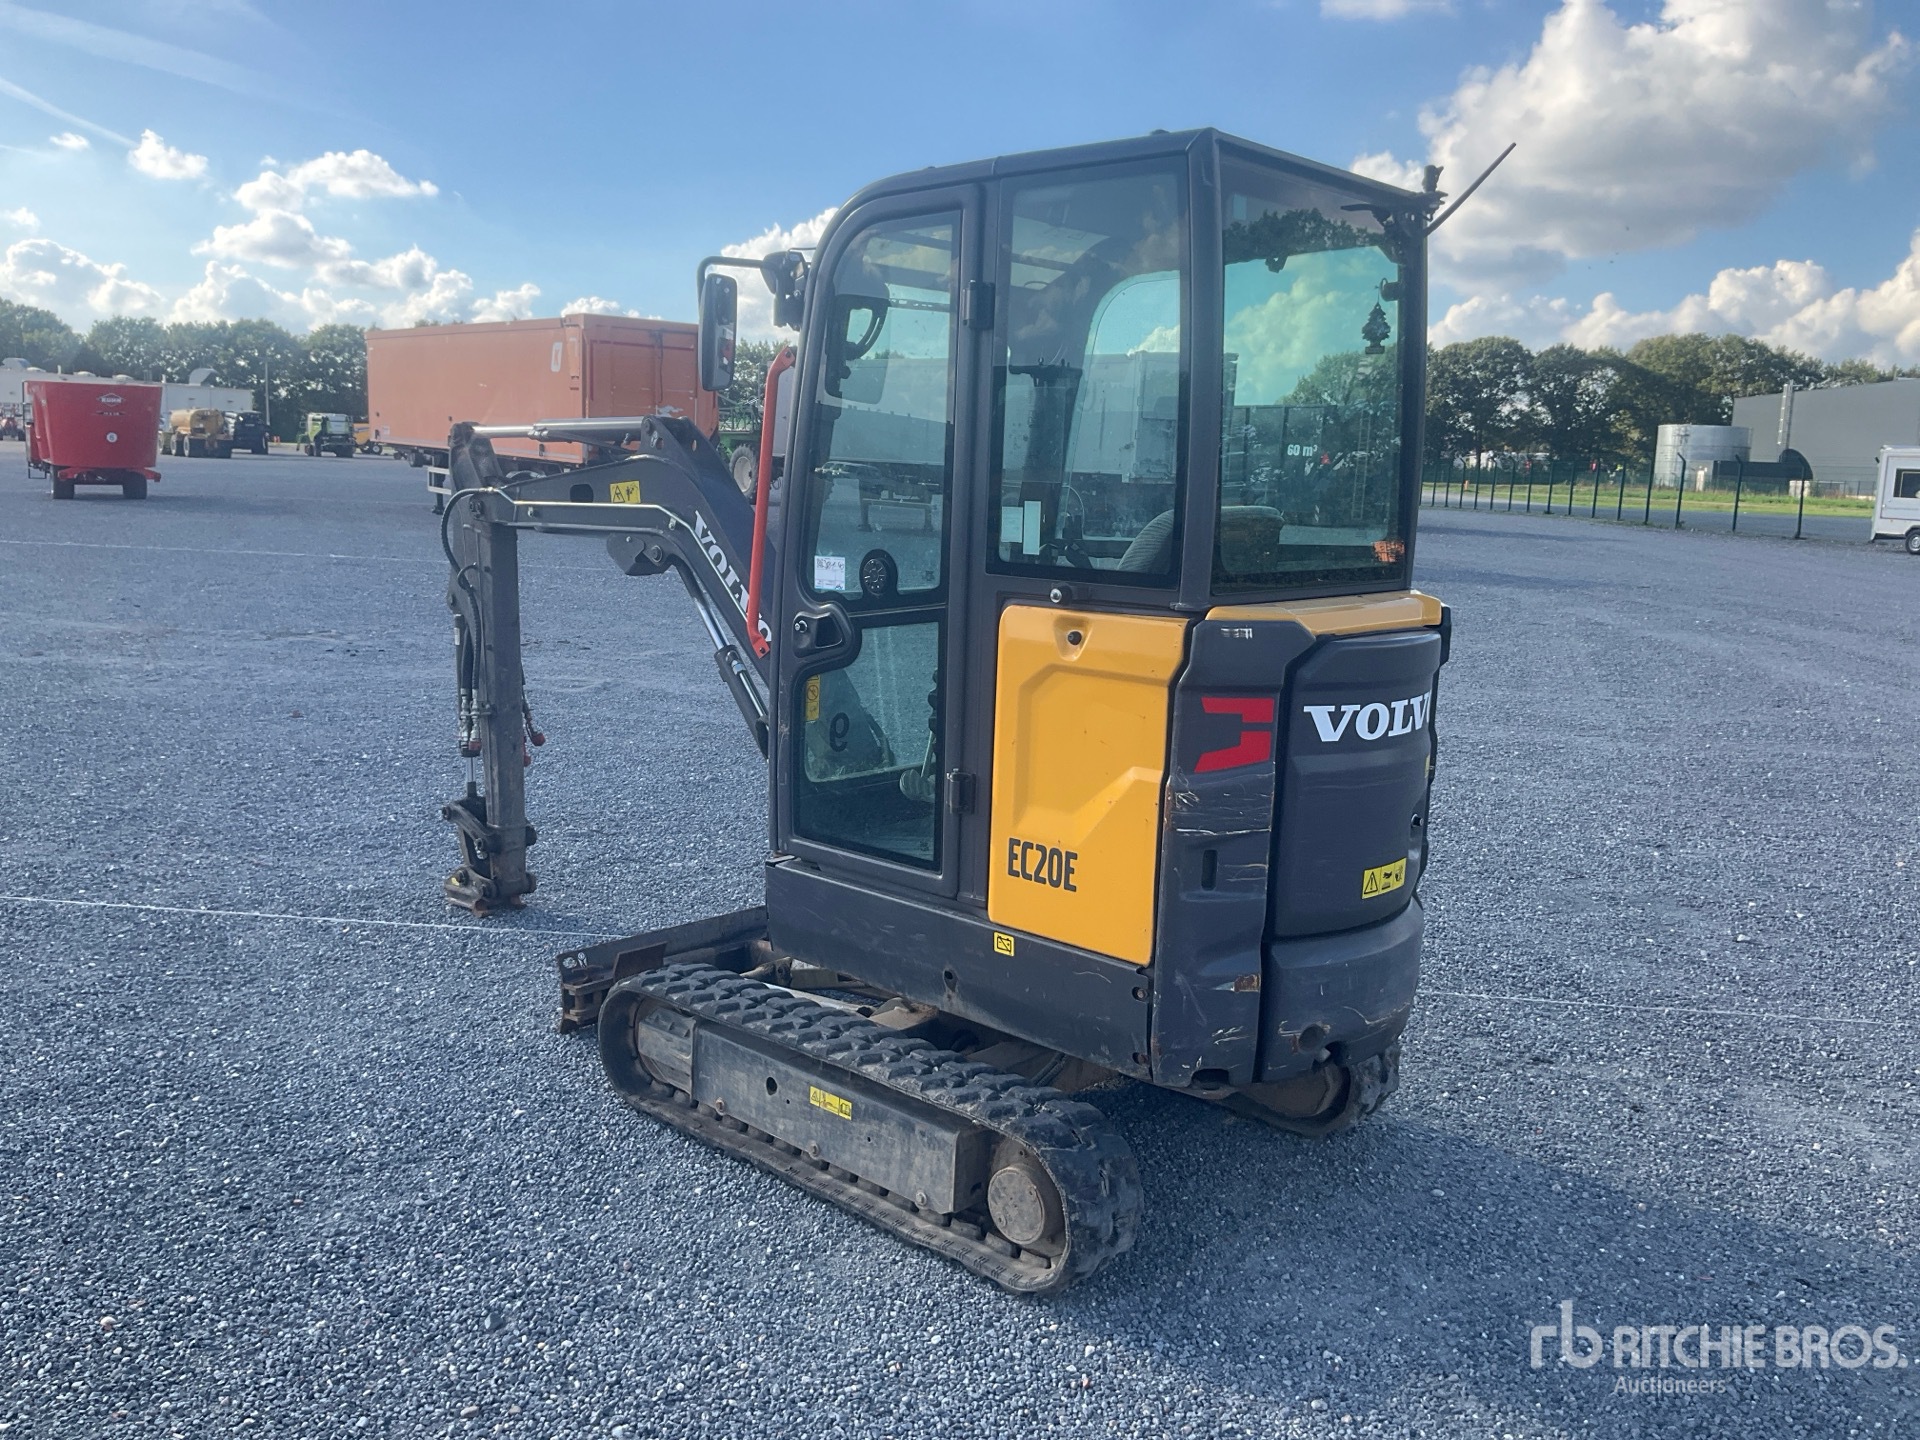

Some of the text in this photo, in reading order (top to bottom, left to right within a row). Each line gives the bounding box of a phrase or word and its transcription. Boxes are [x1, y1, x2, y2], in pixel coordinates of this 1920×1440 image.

[1287, 444, 1300, 456] 60
[1303, 690, 1432, 742] VOLV
[1007, 837, 1078, 892] EC20E
